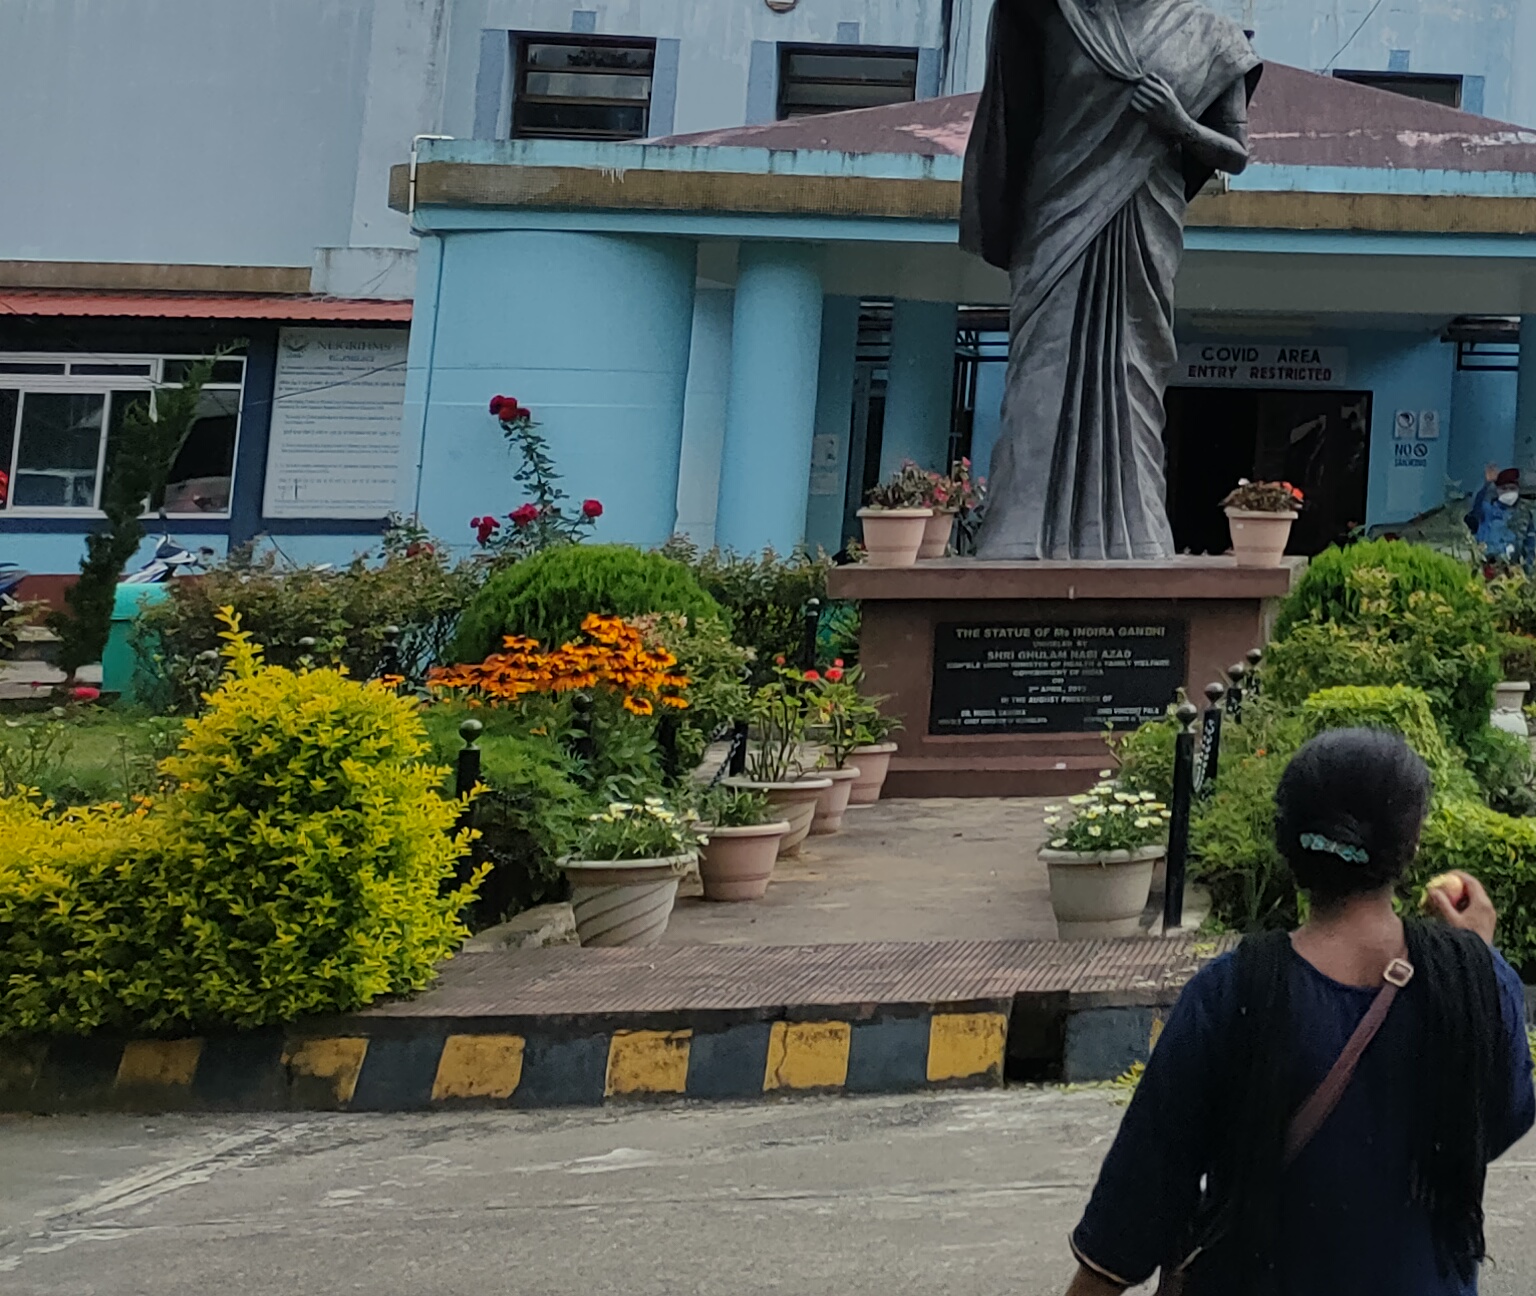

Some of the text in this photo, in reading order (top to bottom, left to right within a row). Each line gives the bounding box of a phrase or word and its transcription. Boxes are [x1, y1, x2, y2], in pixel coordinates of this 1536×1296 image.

[1202, 347, 1322, 364] COVID AREA
[1188, 365, 1332, 382] ENTRY RESTRICTED
[1395, 443, 1412, 456] NO
[956, 627, 981, 638] THE
[1034, 627, 1051, 638] OF
[1073, 627, 1115, 637] INDIRA
[1118, 626, 1166, 637] GANDHI
[987, 650, 1015, 660] SHRI
[1101, 649, 1132, 659] AZAD
